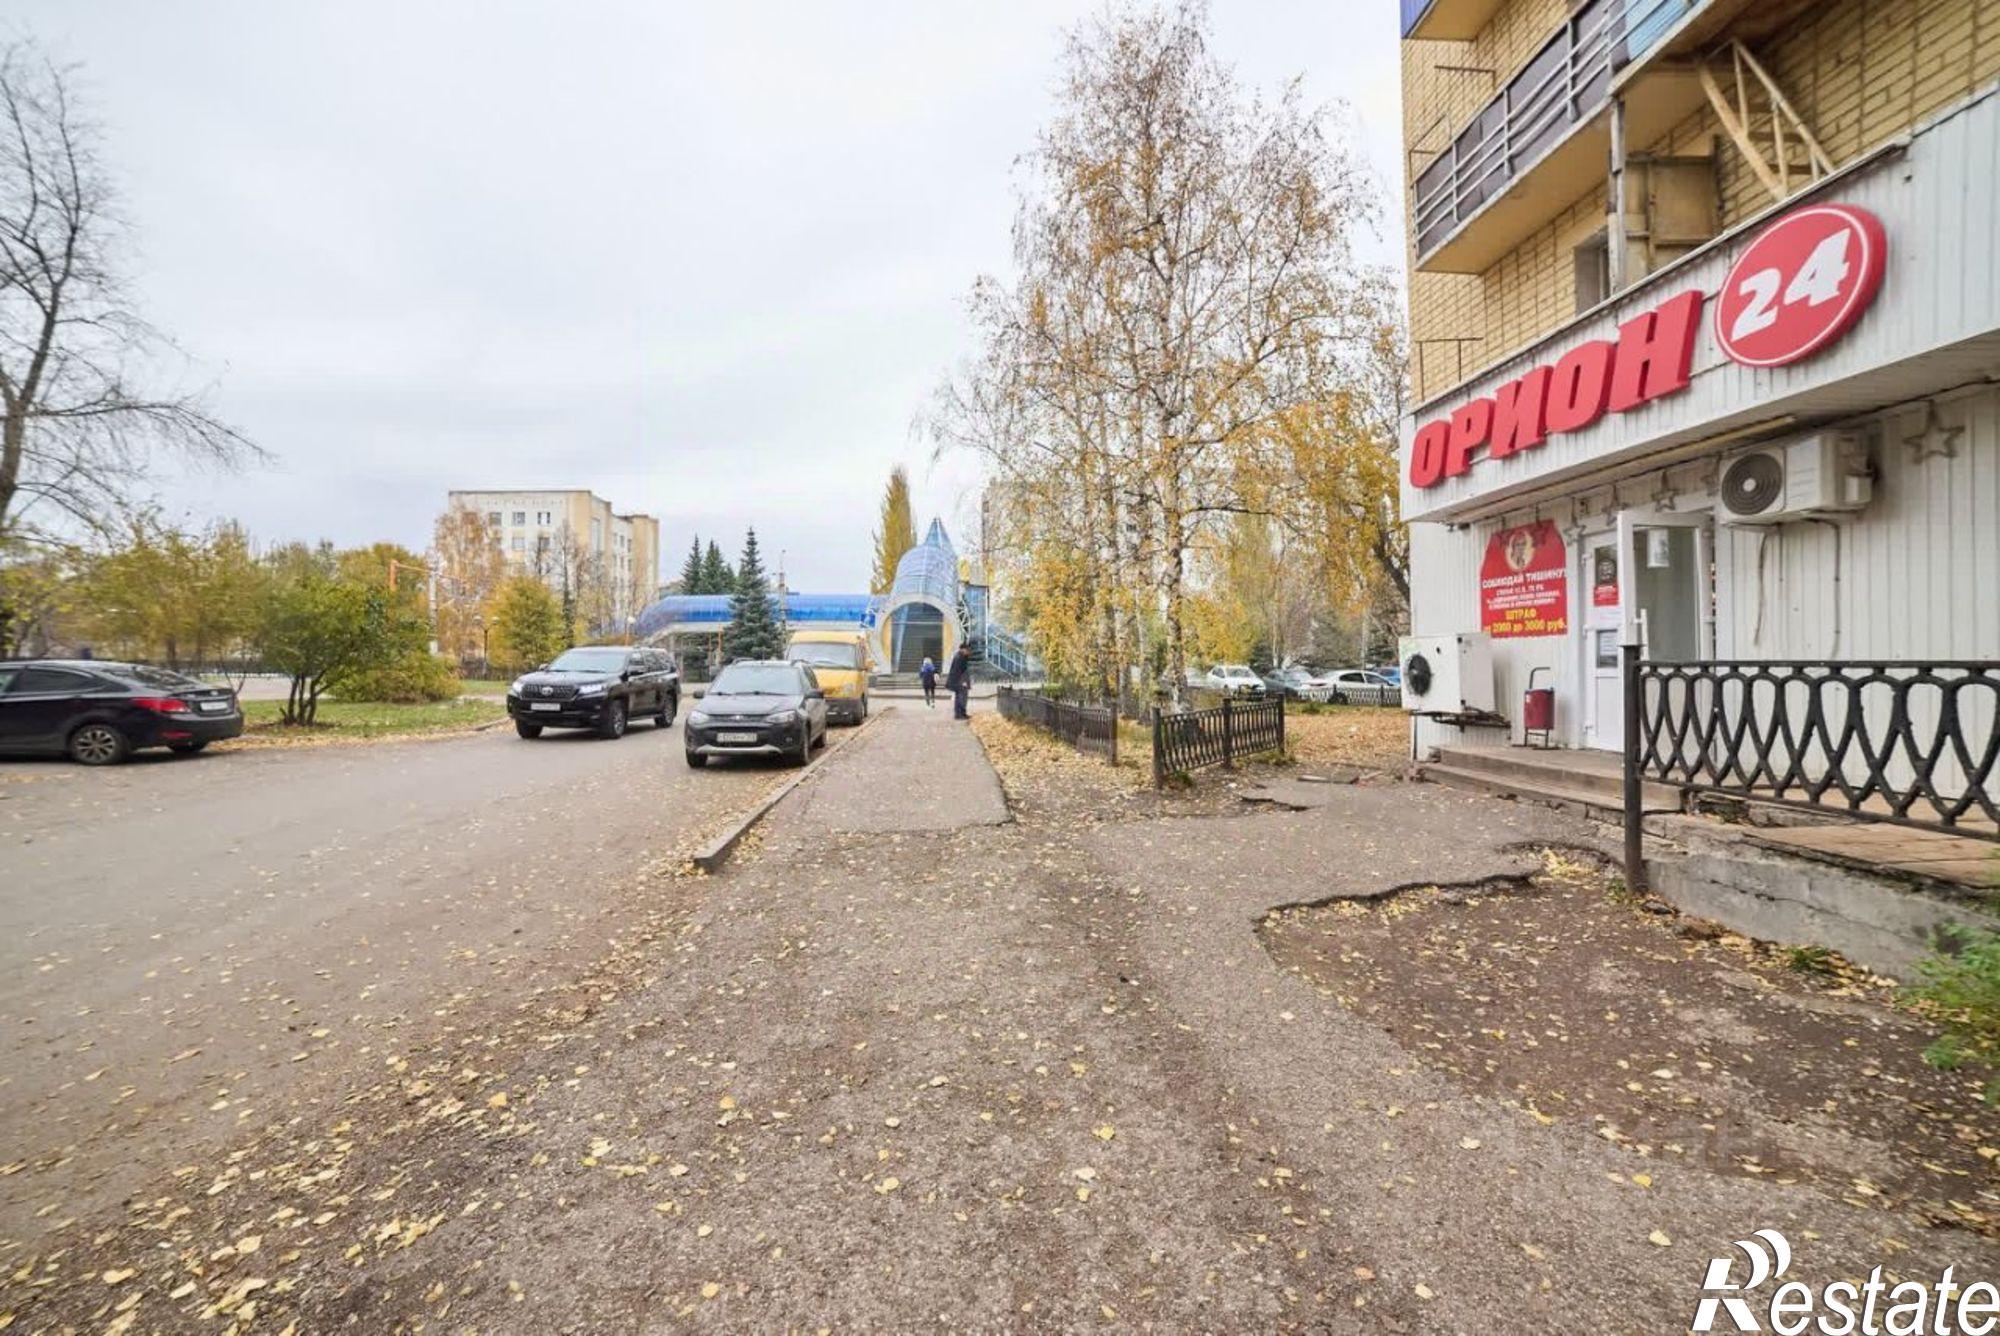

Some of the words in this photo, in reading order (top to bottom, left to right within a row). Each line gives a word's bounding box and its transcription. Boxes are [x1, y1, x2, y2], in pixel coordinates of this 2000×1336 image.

[1410, 289, 1702, 488] ОРИОН
[1731, 227, 1851, 342] 24
[1505, 608, 1537, 621] ШТРАФ
